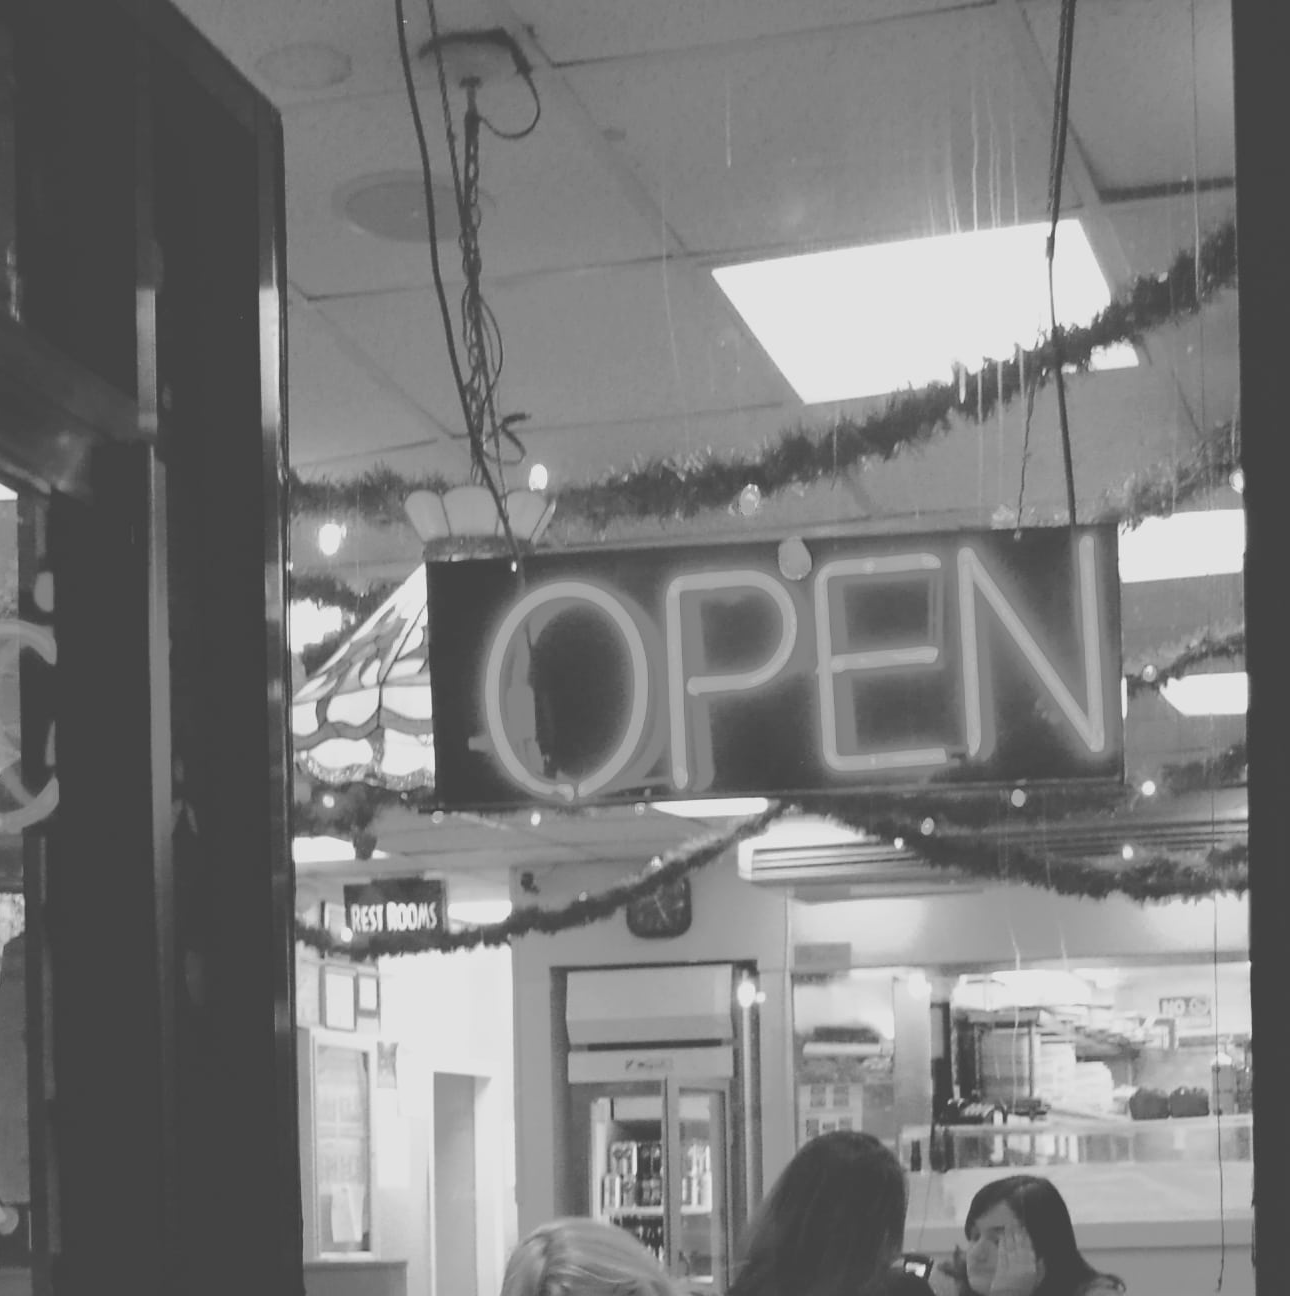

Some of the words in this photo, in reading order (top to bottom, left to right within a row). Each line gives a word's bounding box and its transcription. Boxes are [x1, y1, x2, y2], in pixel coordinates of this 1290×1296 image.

[485, 535, 1105, 800] OPEN
[351, 903, 383, 932] REST
[386, 901, 437, 931] ROOMS
